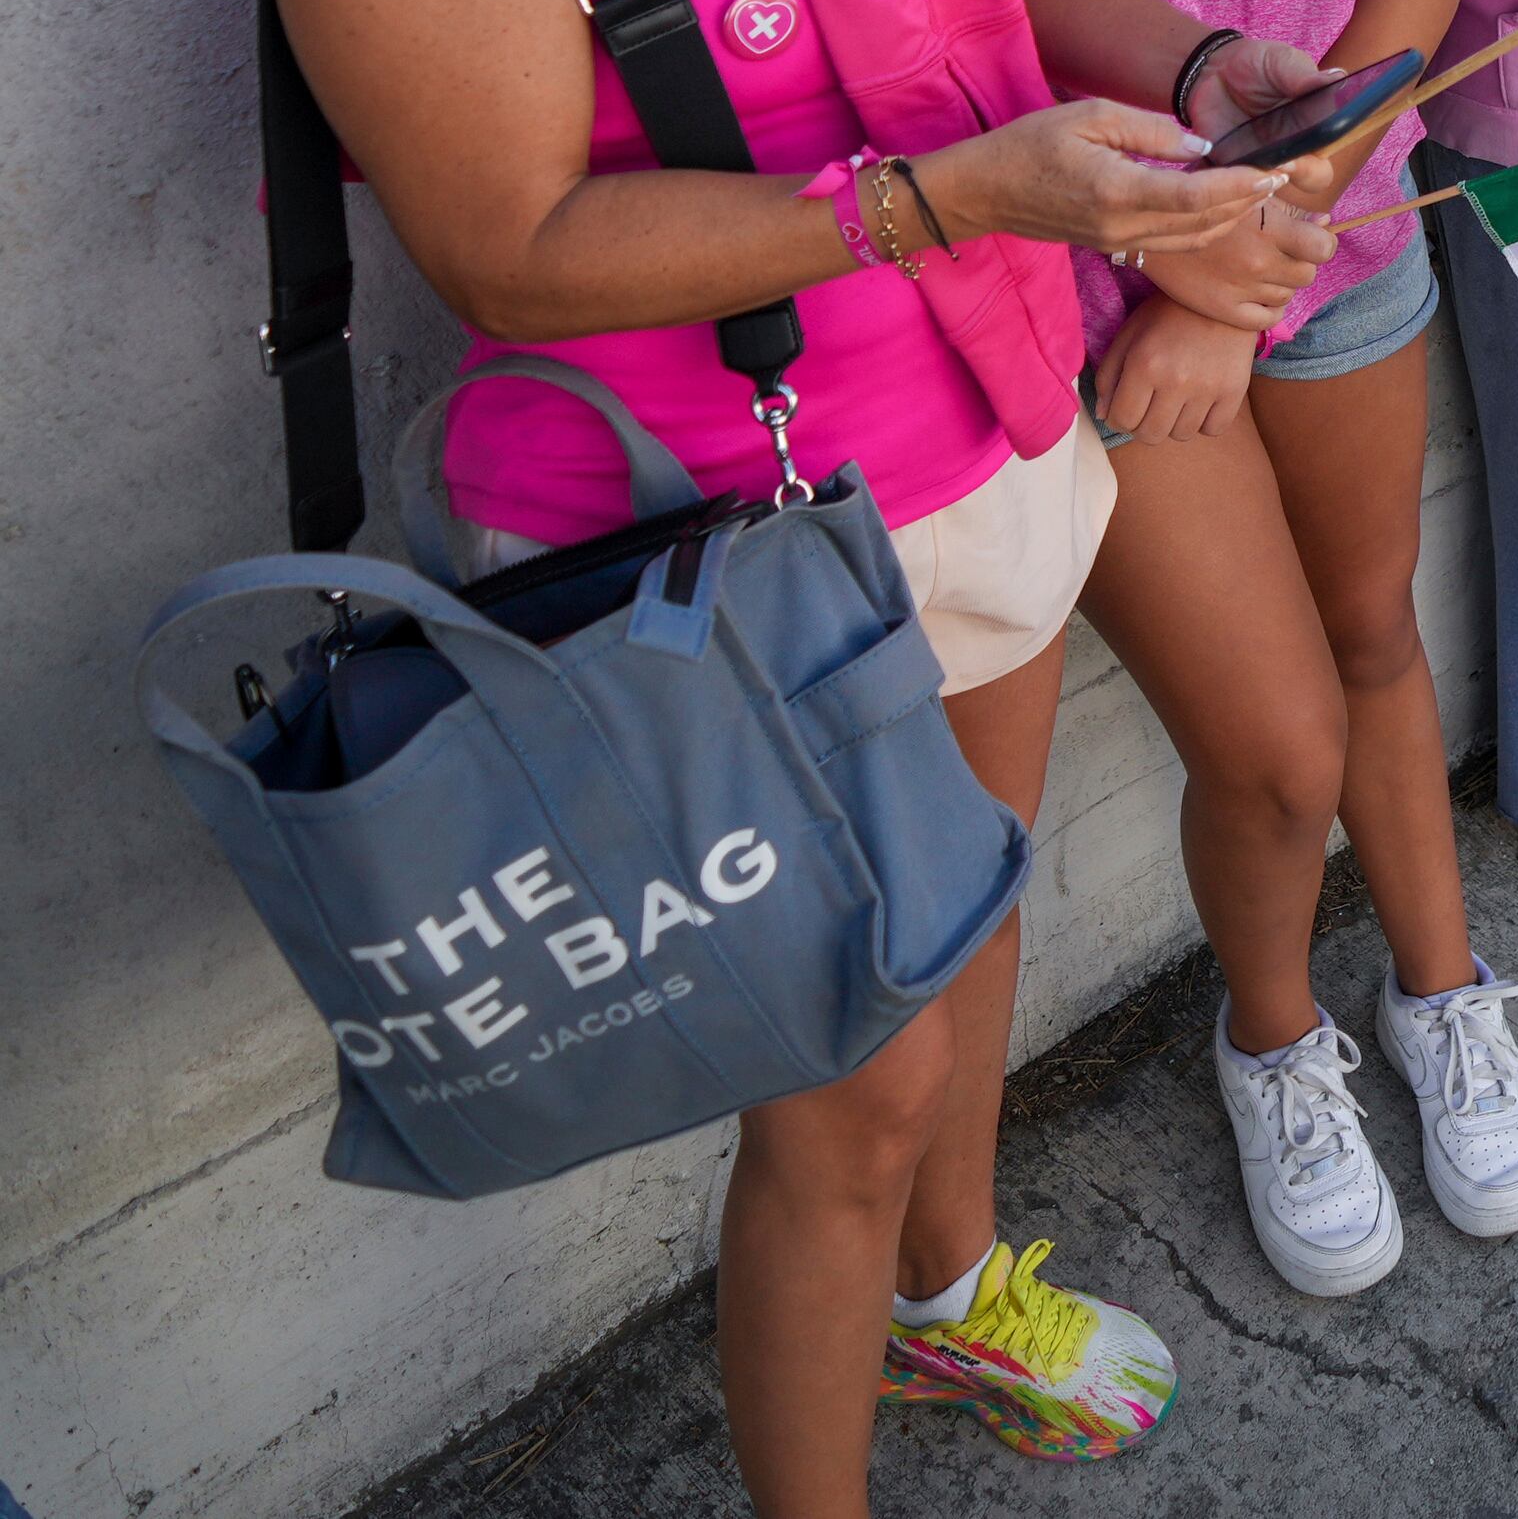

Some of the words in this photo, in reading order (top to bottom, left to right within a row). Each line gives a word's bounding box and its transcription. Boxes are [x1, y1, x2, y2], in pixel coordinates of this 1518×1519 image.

[329, 975, 530, 1069] OTE
[543, 826, 778, 991] BAG
[350, 844, 578, 997] THE
[404, 1060, 520, 1105] MARC
[527, 973, 695, 1062] JACOBS
